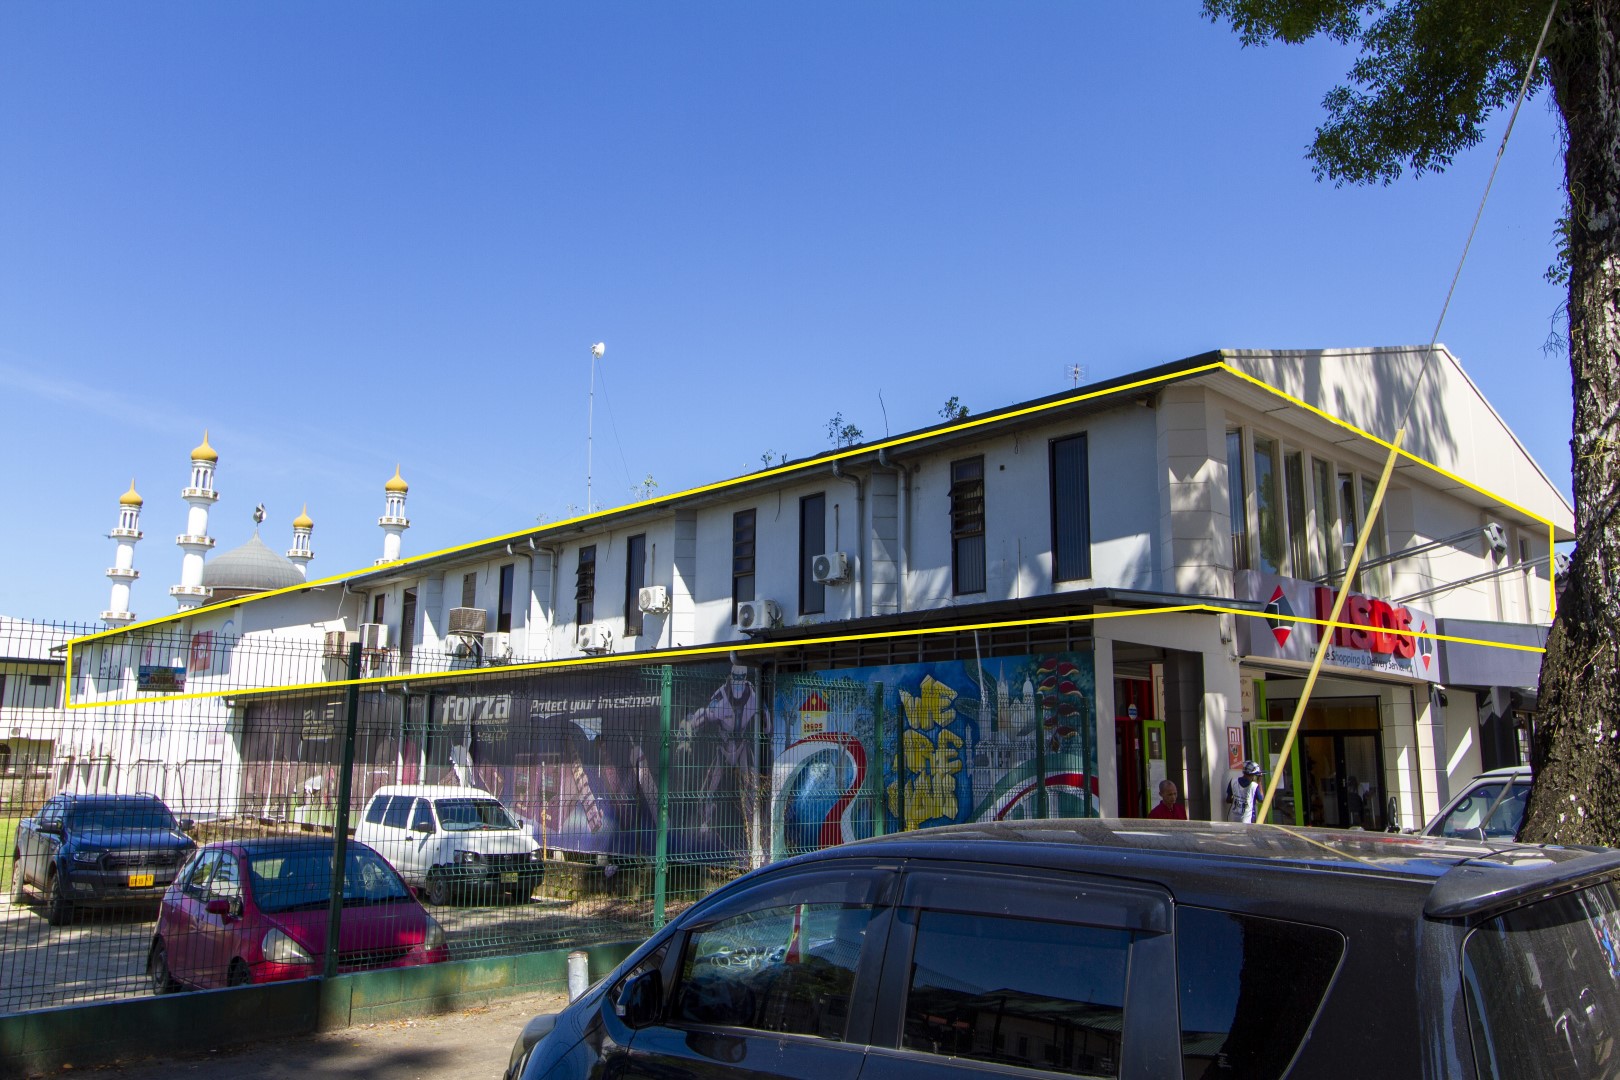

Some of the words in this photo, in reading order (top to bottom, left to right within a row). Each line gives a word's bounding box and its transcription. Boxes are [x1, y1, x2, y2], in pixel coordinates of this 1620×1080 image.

[1315, 586, 1416, 659] HSDS
[1331, 651, 1360, 667] Shopping
[1361, 656, 1366, 665] &
[1367, 656, 1388, 671] Delivery
[442, 694, 512, 725] forza
[530, 699, 568, 713] Protect
[569, 699, 596, 714] your
[899, 674, 958, 731] WE
[893, 728, 963, 776] ARE
